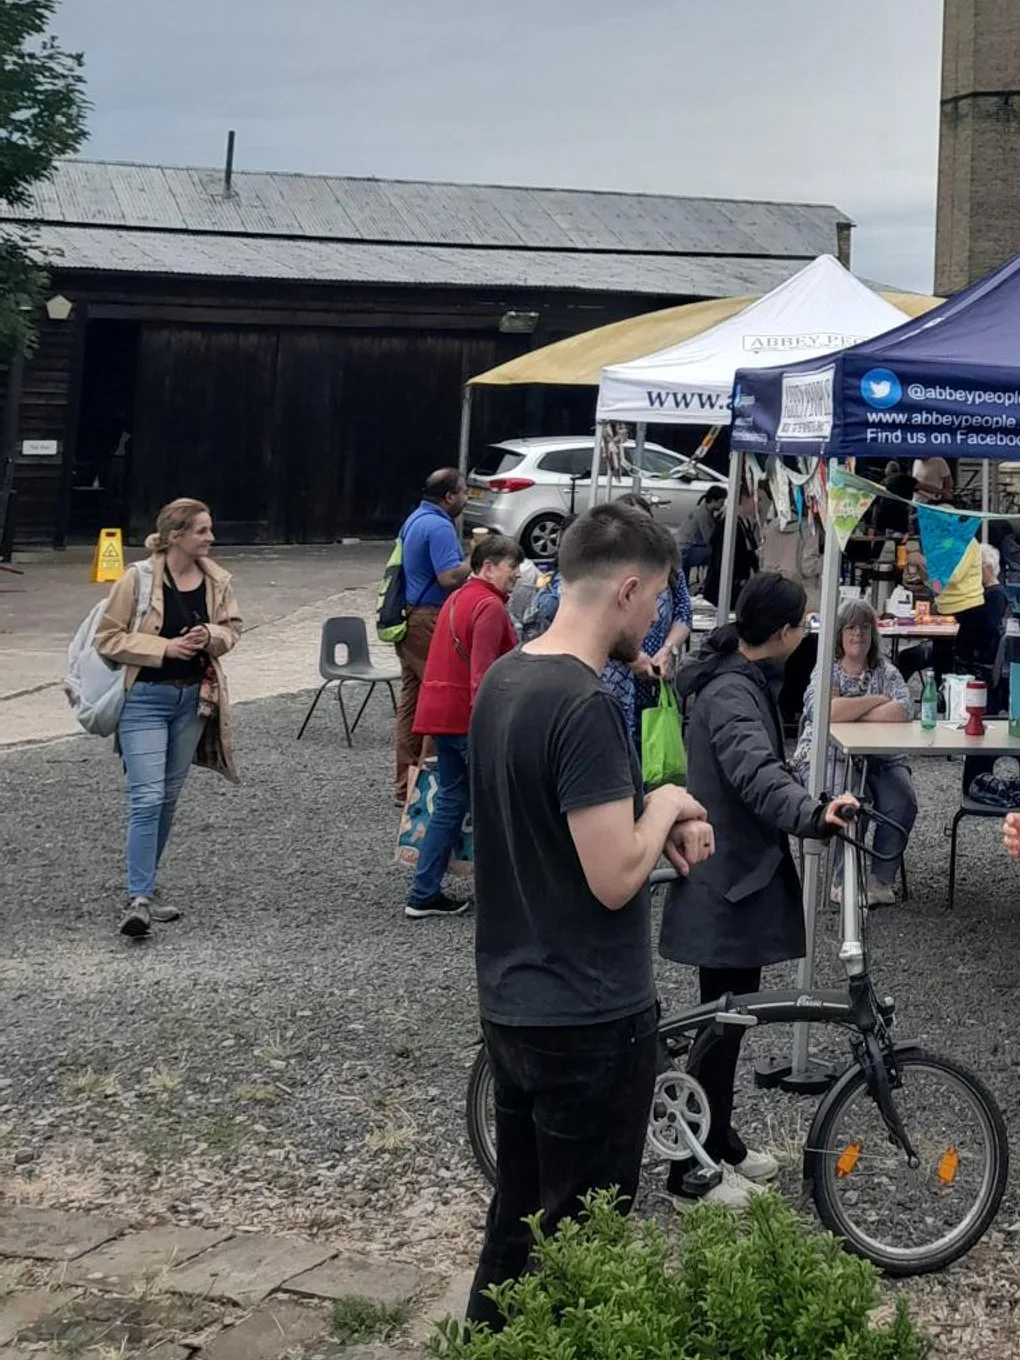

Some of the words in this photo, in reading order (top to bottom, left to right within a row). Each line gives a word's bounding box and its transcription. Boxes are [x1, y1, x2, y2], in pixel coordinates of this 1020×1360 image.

[866, 428, 902, 444] Find
[907, 433, 926, 444] us
[930, 433, 951, 444] on
